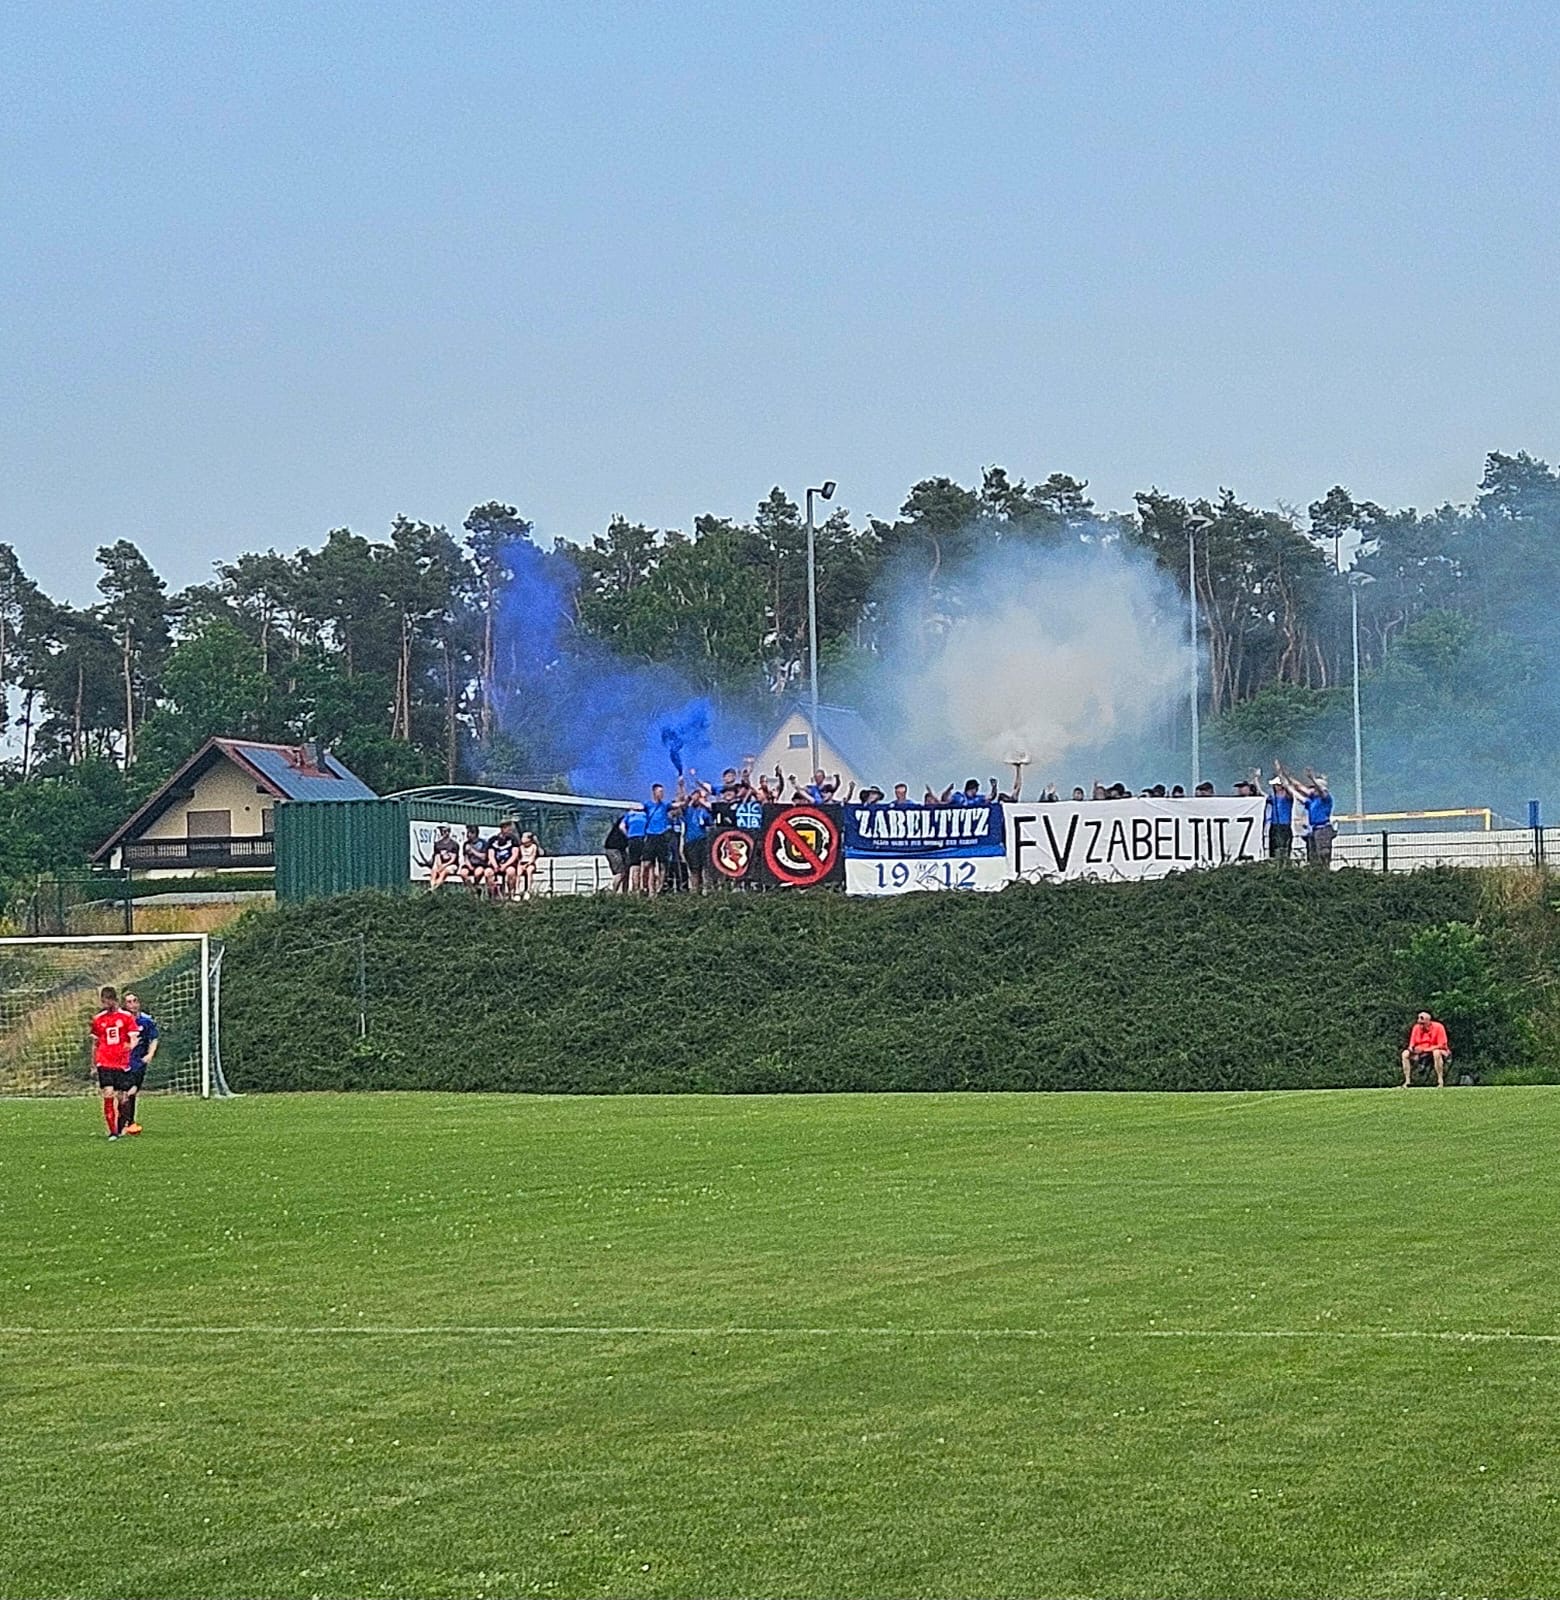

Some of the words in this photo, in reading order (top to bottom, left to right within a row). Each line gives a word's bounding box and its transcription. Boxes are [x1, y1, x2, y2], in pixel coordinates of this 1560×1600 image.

[855, 807, 989, 838] ZABELTITZ
[1013, 814, 1079, 873] FV
[1084, 817, 1254, 863] ZABELTITZ
[875, 861, 910, 888] 19
[942, 861, 977, 888] 12
